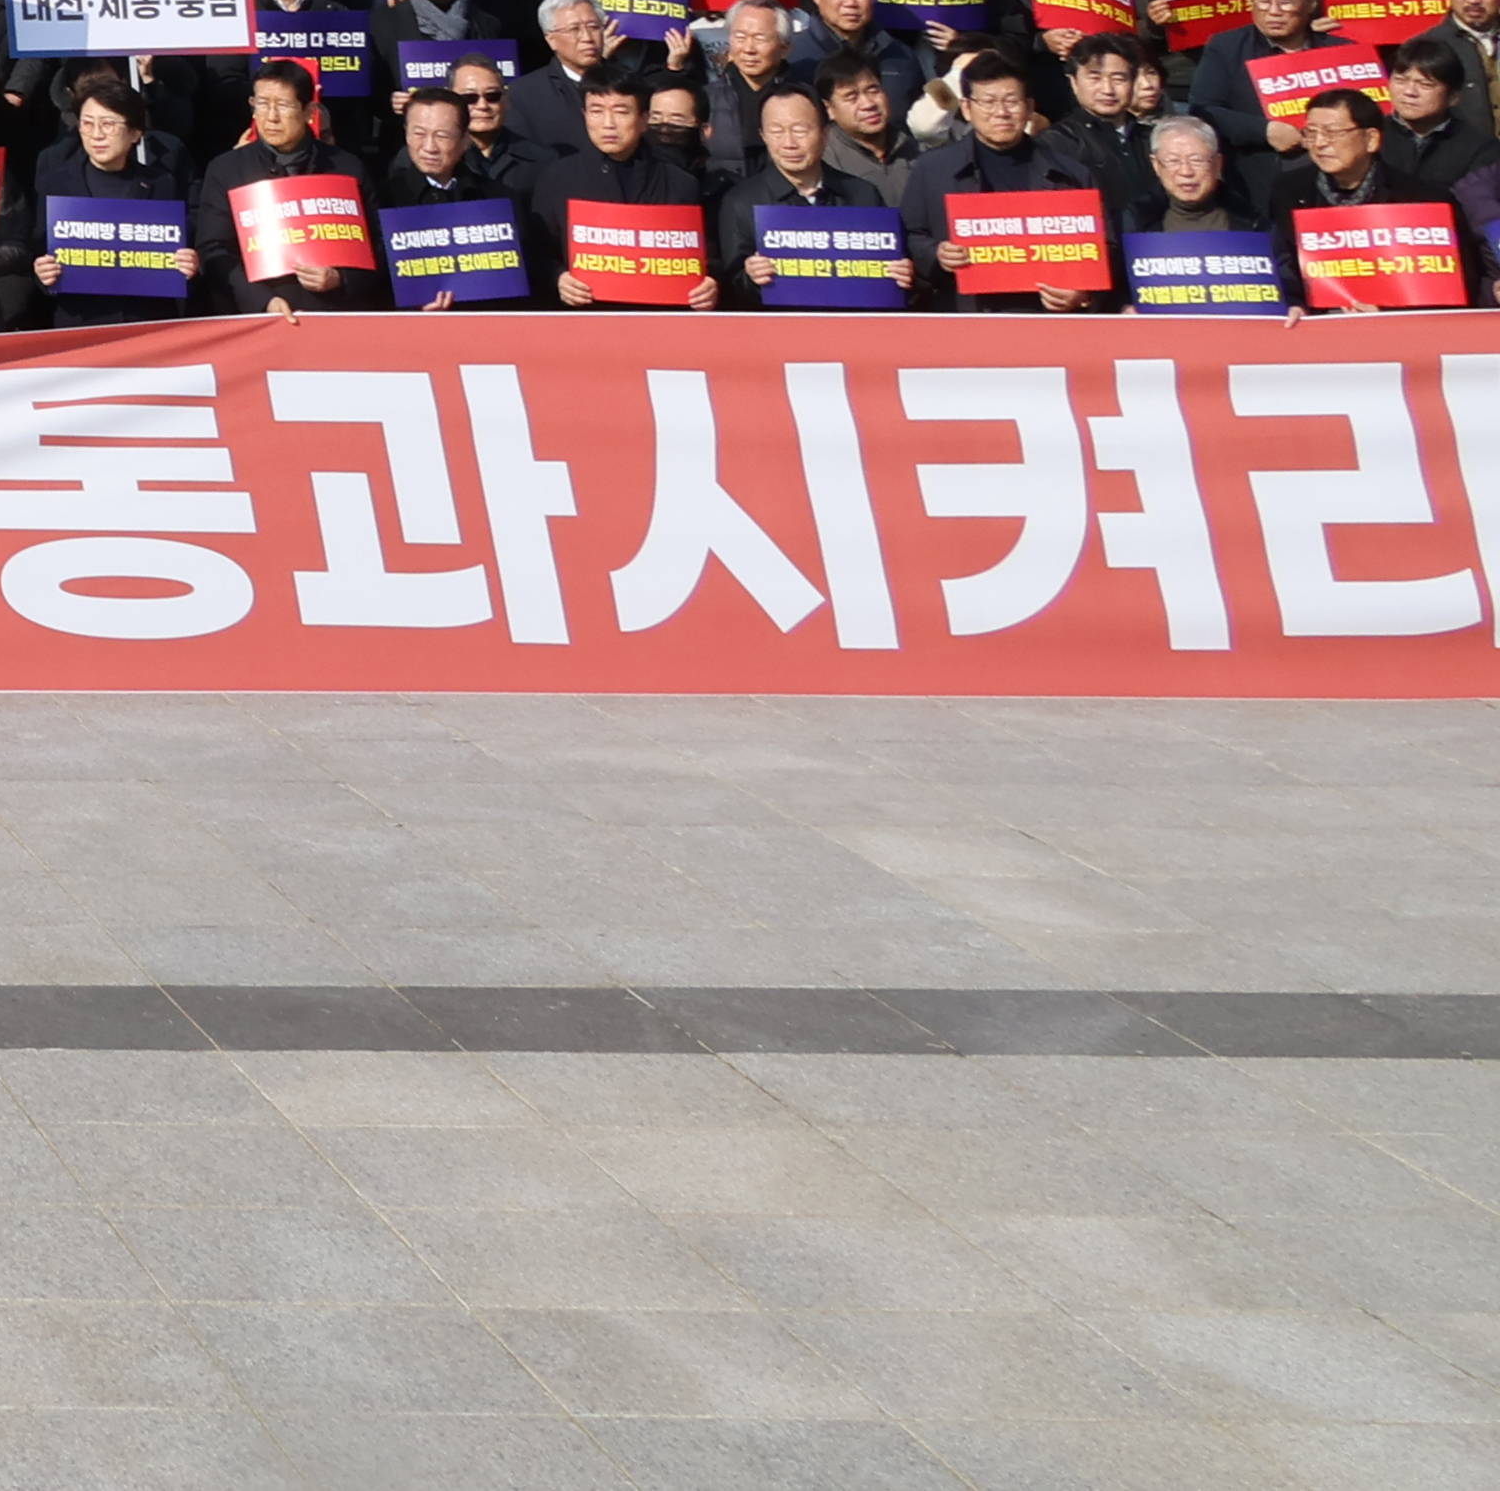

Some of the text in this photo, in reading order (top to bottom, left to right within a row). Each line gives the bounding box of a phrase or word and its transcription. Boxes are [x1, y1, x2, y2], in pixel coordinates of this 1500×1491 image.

[53, 221, 181, 242] 산재예방 동참한다
[391, 223, 513, 250] 산재예방 동참한다
[573, 225, 698, 248] 중대재해 불안감에
[955, 216, 1095, 236] 중대재해 불안감에
[763, 231, 896, 250] 산재예방 동참한다
[1301, 227, 1450, 251] 중소기업 다 죽으면
[1030, 243, 1098, 262] 기업의욕
[396, 251, 518, 276] 처벌불안 없애달라
[573, 253, 700, 275] 사라지는 기업의욕
[1133, 256, 1272, 276] 산재예방 동참한다
[1306, 256, 1455, 277] 아파트는 누가 짓나
[1137, 284, 1278, 304] 처벌불안 없애달라
